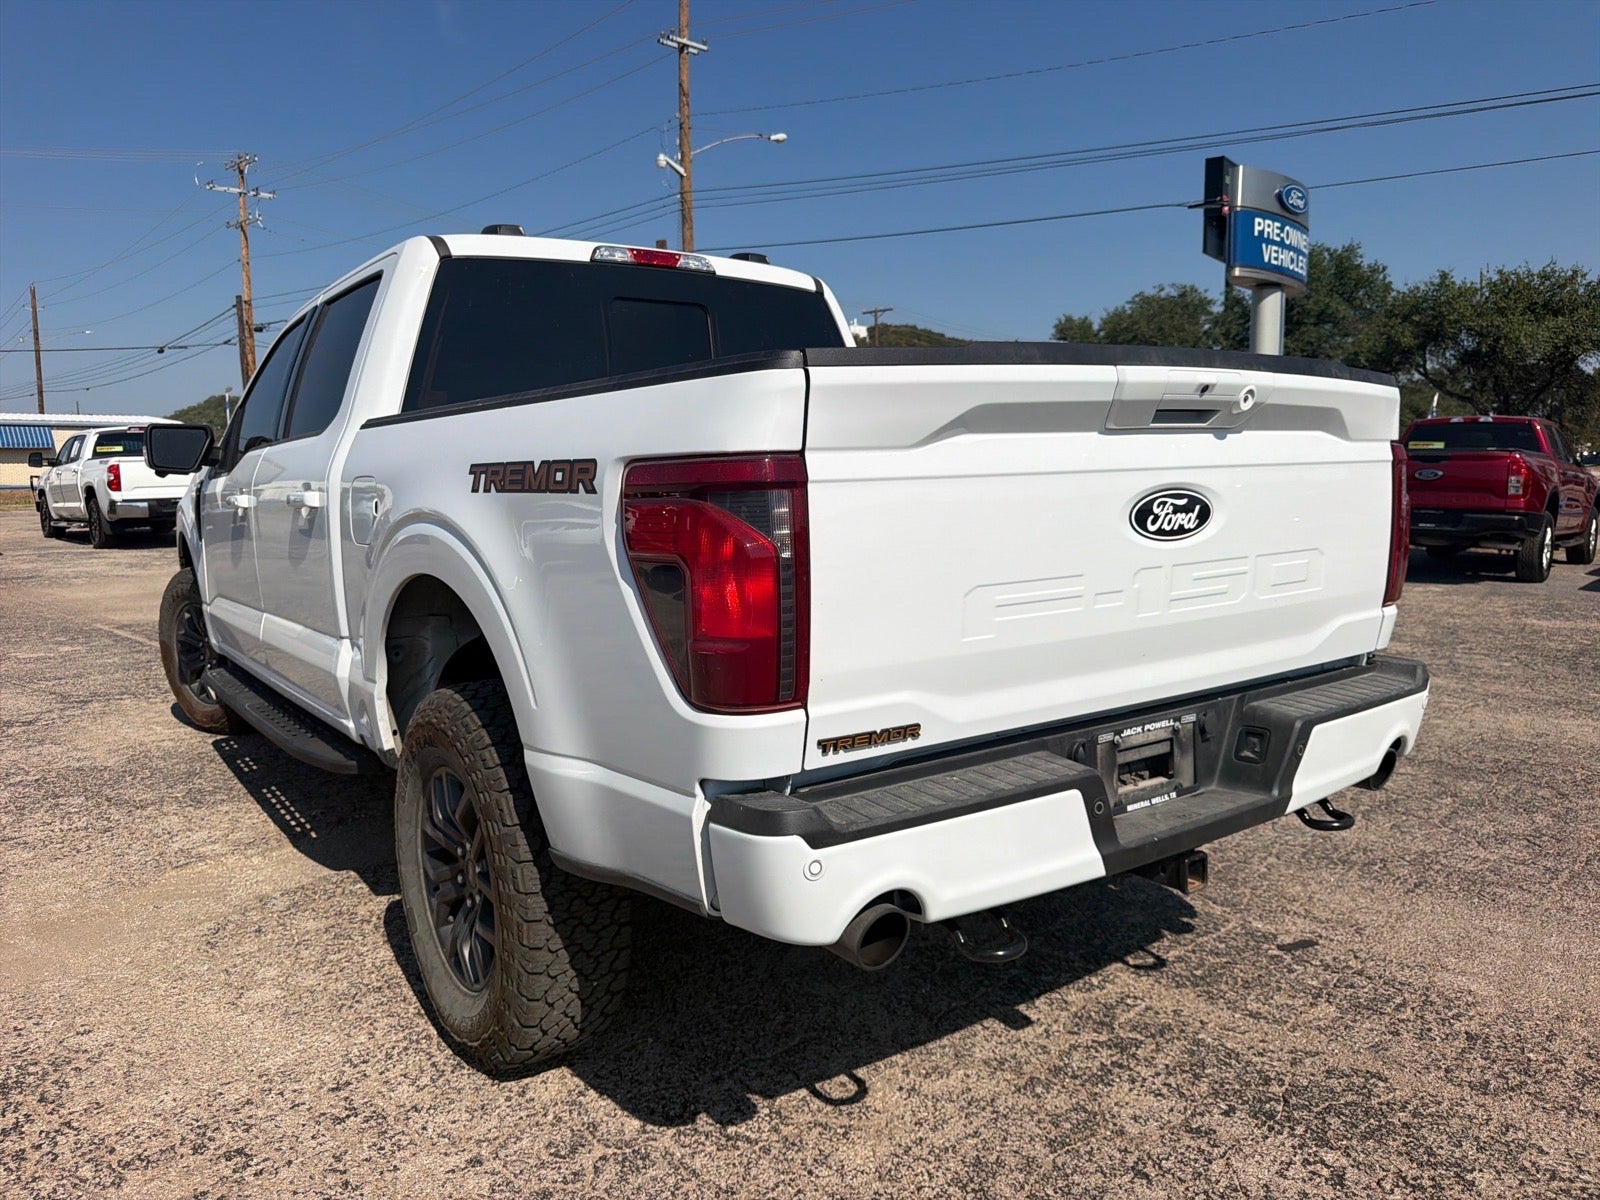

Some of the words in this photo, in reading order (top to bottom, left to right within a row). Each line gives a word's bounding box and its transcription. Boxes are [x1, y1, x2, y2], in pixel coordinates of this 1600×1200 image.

[1254, 217, 1309, 254] PRE-OWNE
[469, 458, 598, 494] TREMOR
[961, 548, 1324, 642] F-150
[817, 723, 921, 756] TREMOR
[1120, 725, 1143, 737] JACK
[1144, 719, 1175, 732] POWELL
[1126, 800, 1151, 812] MINERAL
